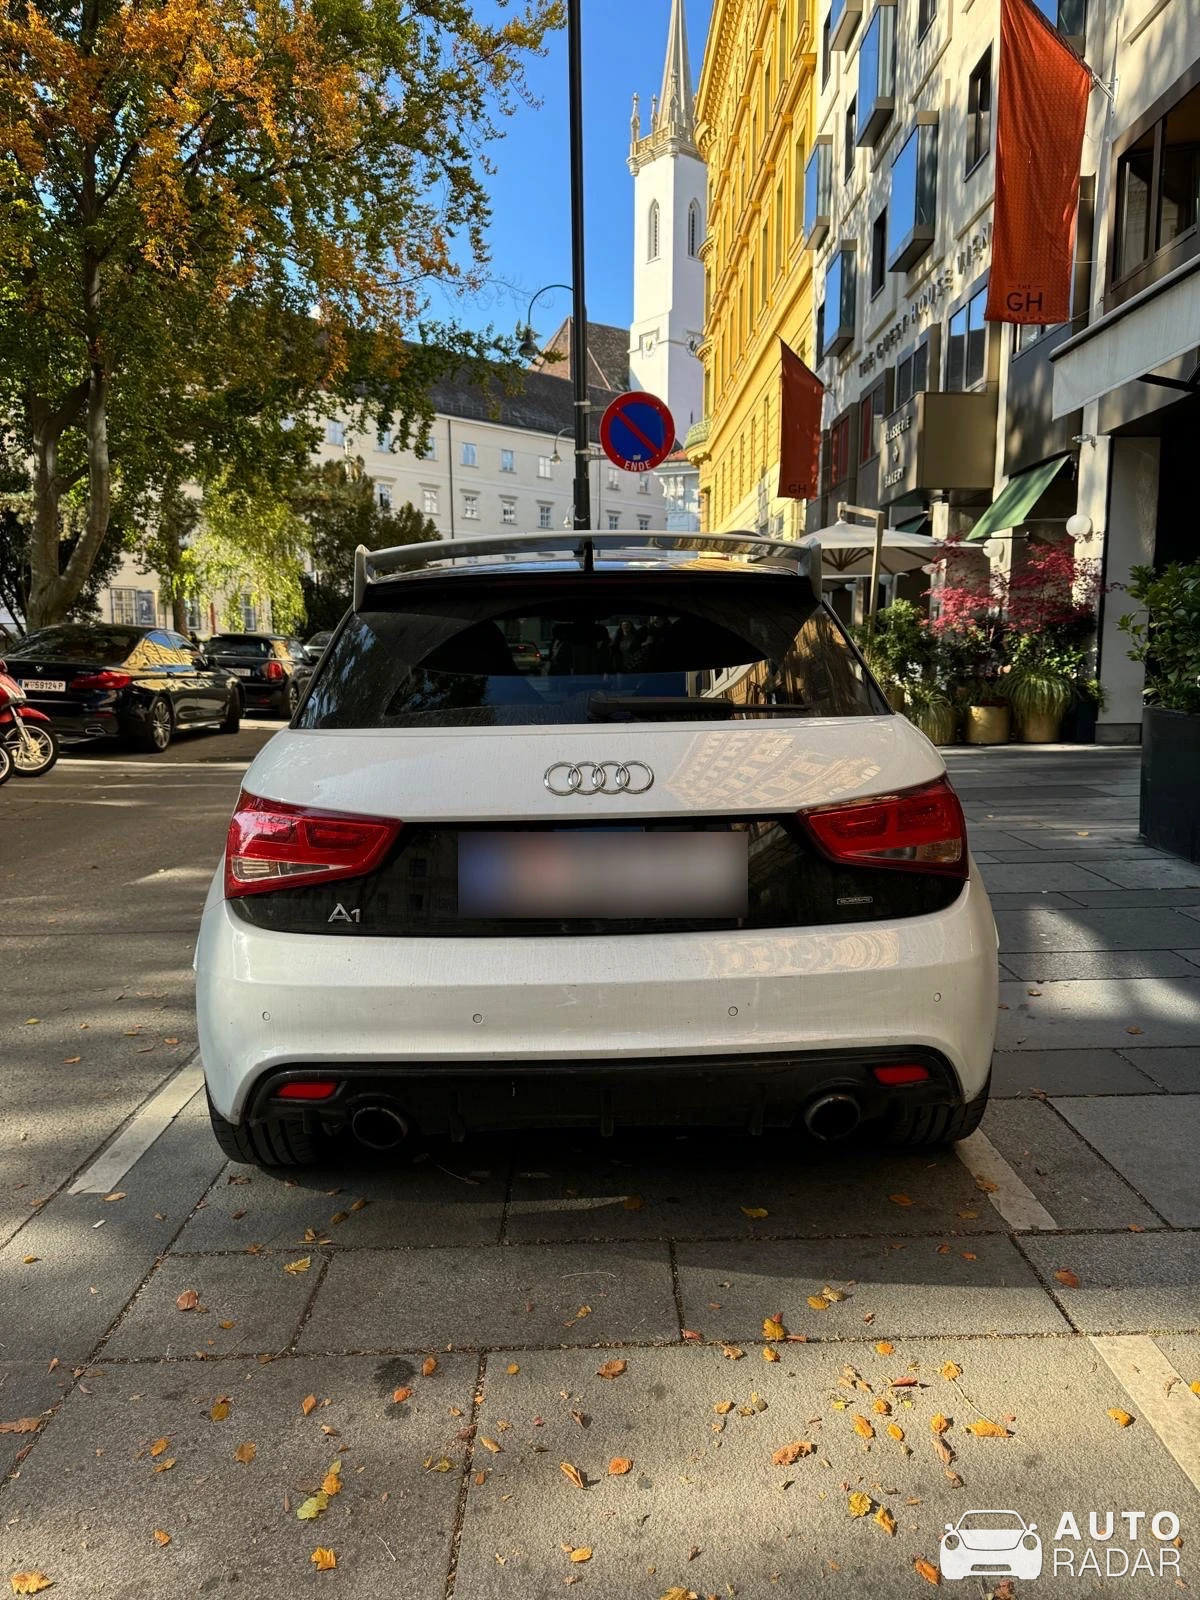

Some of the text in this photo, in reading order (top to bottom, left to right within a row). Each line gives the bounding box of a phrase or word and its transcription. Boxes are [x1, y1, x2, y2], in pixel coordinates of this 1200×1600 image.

[957, 222, 993, 275] VIEN
[1007, 292, 1043, 312] GH
[624, 460, 651, 471] ENDE
[788, 483, 807, 494] GH
[327, 902, 361, 923] A1
